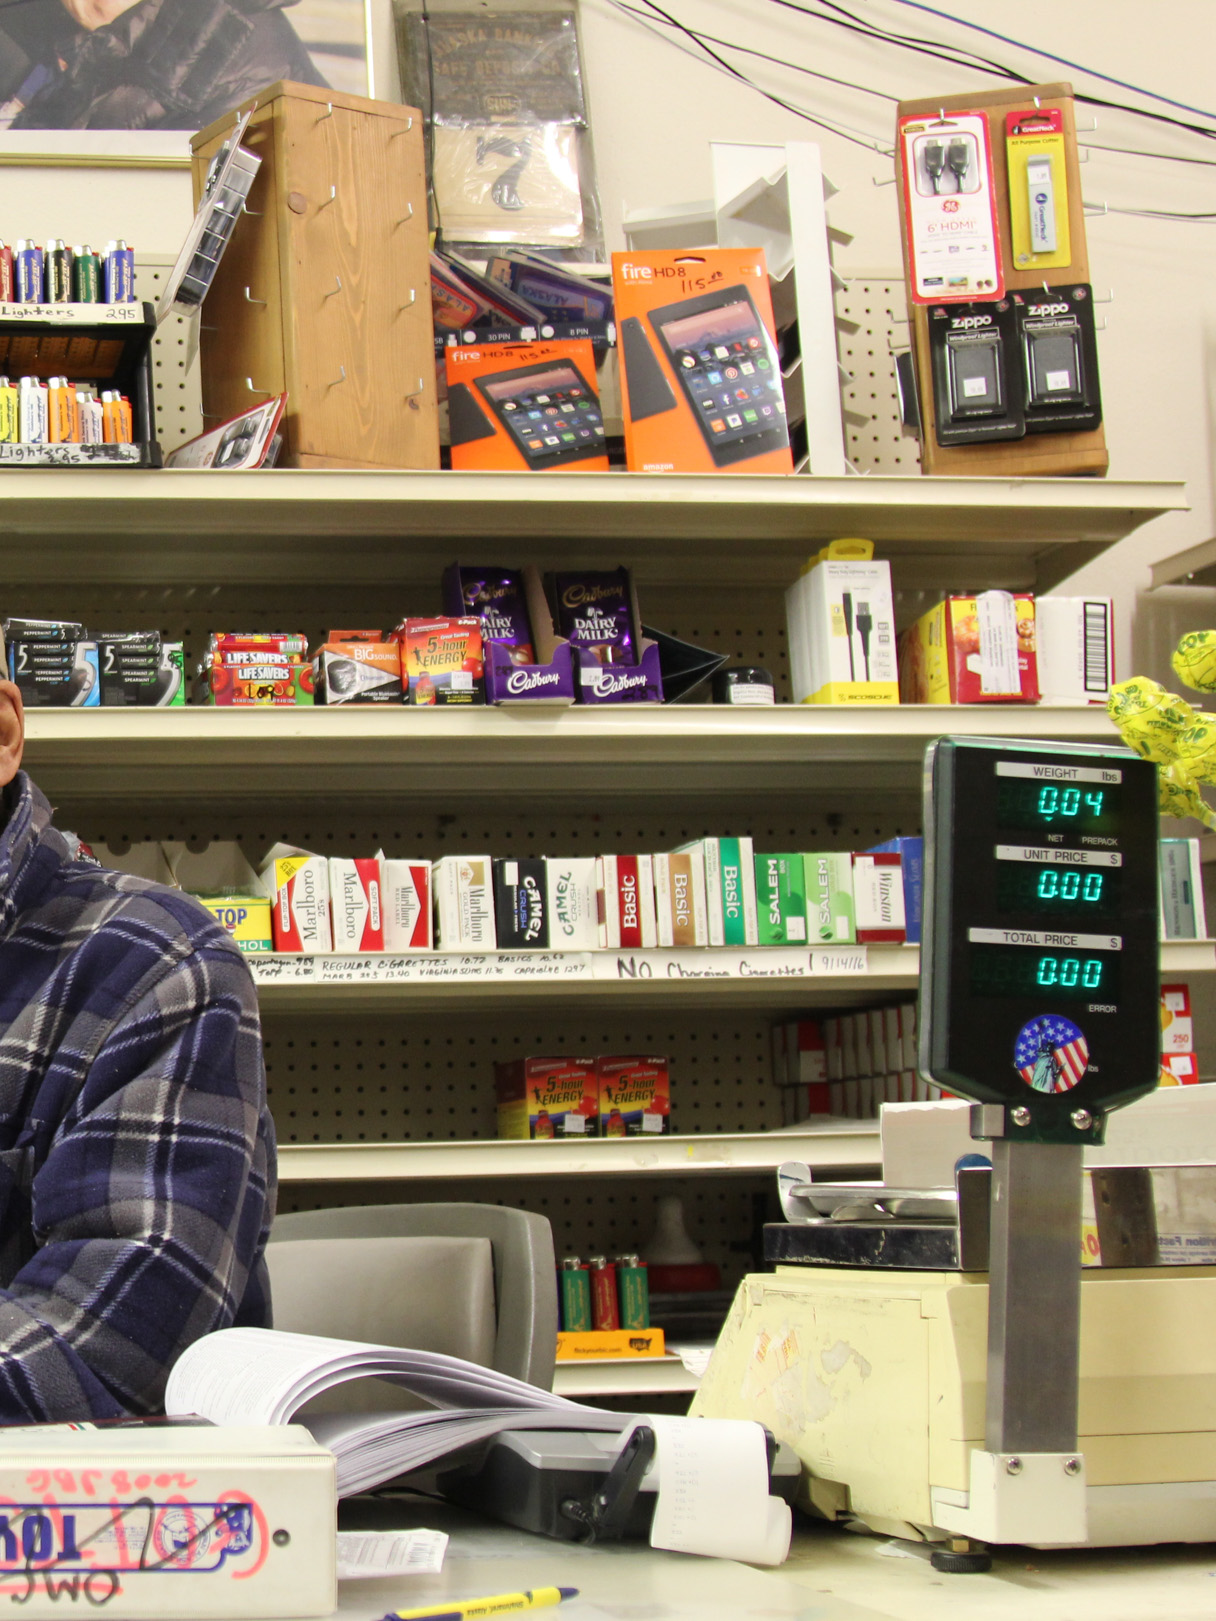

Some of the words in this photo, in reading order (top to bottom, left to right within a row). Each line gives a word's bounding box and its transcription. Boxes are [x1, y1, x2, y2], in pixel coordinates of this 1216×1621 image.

[621, 263, 652, 280] fire
[1, 305, 75, 319] Lighters
[1028, 303, 1069, 317] zippo
[952, 315, 992, 330] zippo
[488, 334, 497, 342] 30
[497, 333, 511, 342] PIN
[575, 328, 589, 336] PIN
[452, 351, 480, 362] fire
[642, 463, 674, 472] amazon
[574, 616, 617, 631] DAIRY
[577, 628, 618, 641] MILK
[427, 636, 468, 654] 5-hour
[422, 650, 468, 668] ENERGY
[507, 671, 561, 695] Cadbury
[593, 673, 647, 697] Cadbury
[1033, 766, 1079, 780] WEIGHT
[1101, 770, 1118, 782] lbs
[1038, 786, 1104, 817] 0.04
[1047, 833, 1065, 843] NET
[1081, 836, 1119, 847] PREPACK
[1023, 849, 1052, 861] UNIT
[1054, 850, 1088, 863] PRICE
[723, 865, 741, 919] Basic
[767, 858, 782, 926] SALEM
[818, 858, 831, 925] SALEM
[1037, 870, 1103, 901] 0.00
[302, 869, 319, 941] Marlboro
[343, 872, 357, 939] Marlboro
[556, 871, 575, 937] CAMEL
[623, 874, 638, 929] Basic
[674, 873, 691, 928] Basic
[879, 872, 894, 923] Winston
[400, 886, 411, 929] Marlboro
[468, 888, 489, 943] Marlboro
[519, 889, 528, 929] CRUSH
[523, 875, 542, 941] CAMEL
[216, 908, 248, 926] TOP
[1003, 931, 1041, 945] TOTAL
[1044, 933, 1079, 947] PRICE
[1036, 957, 1103, 988] 0.00
[1088, 1003, 1118, 1014] ERROR
[1172, 1033, 1189, 1043] 250
[546, 1075, 584, 1092] 5-hour
[617, 1075, 656, 1091] 5-hour
[541, 1089, 584, 1105] ENERGY
[613, 1088, 656, 1104] ENERGY
[631, 1342, 649, 1350] USA
